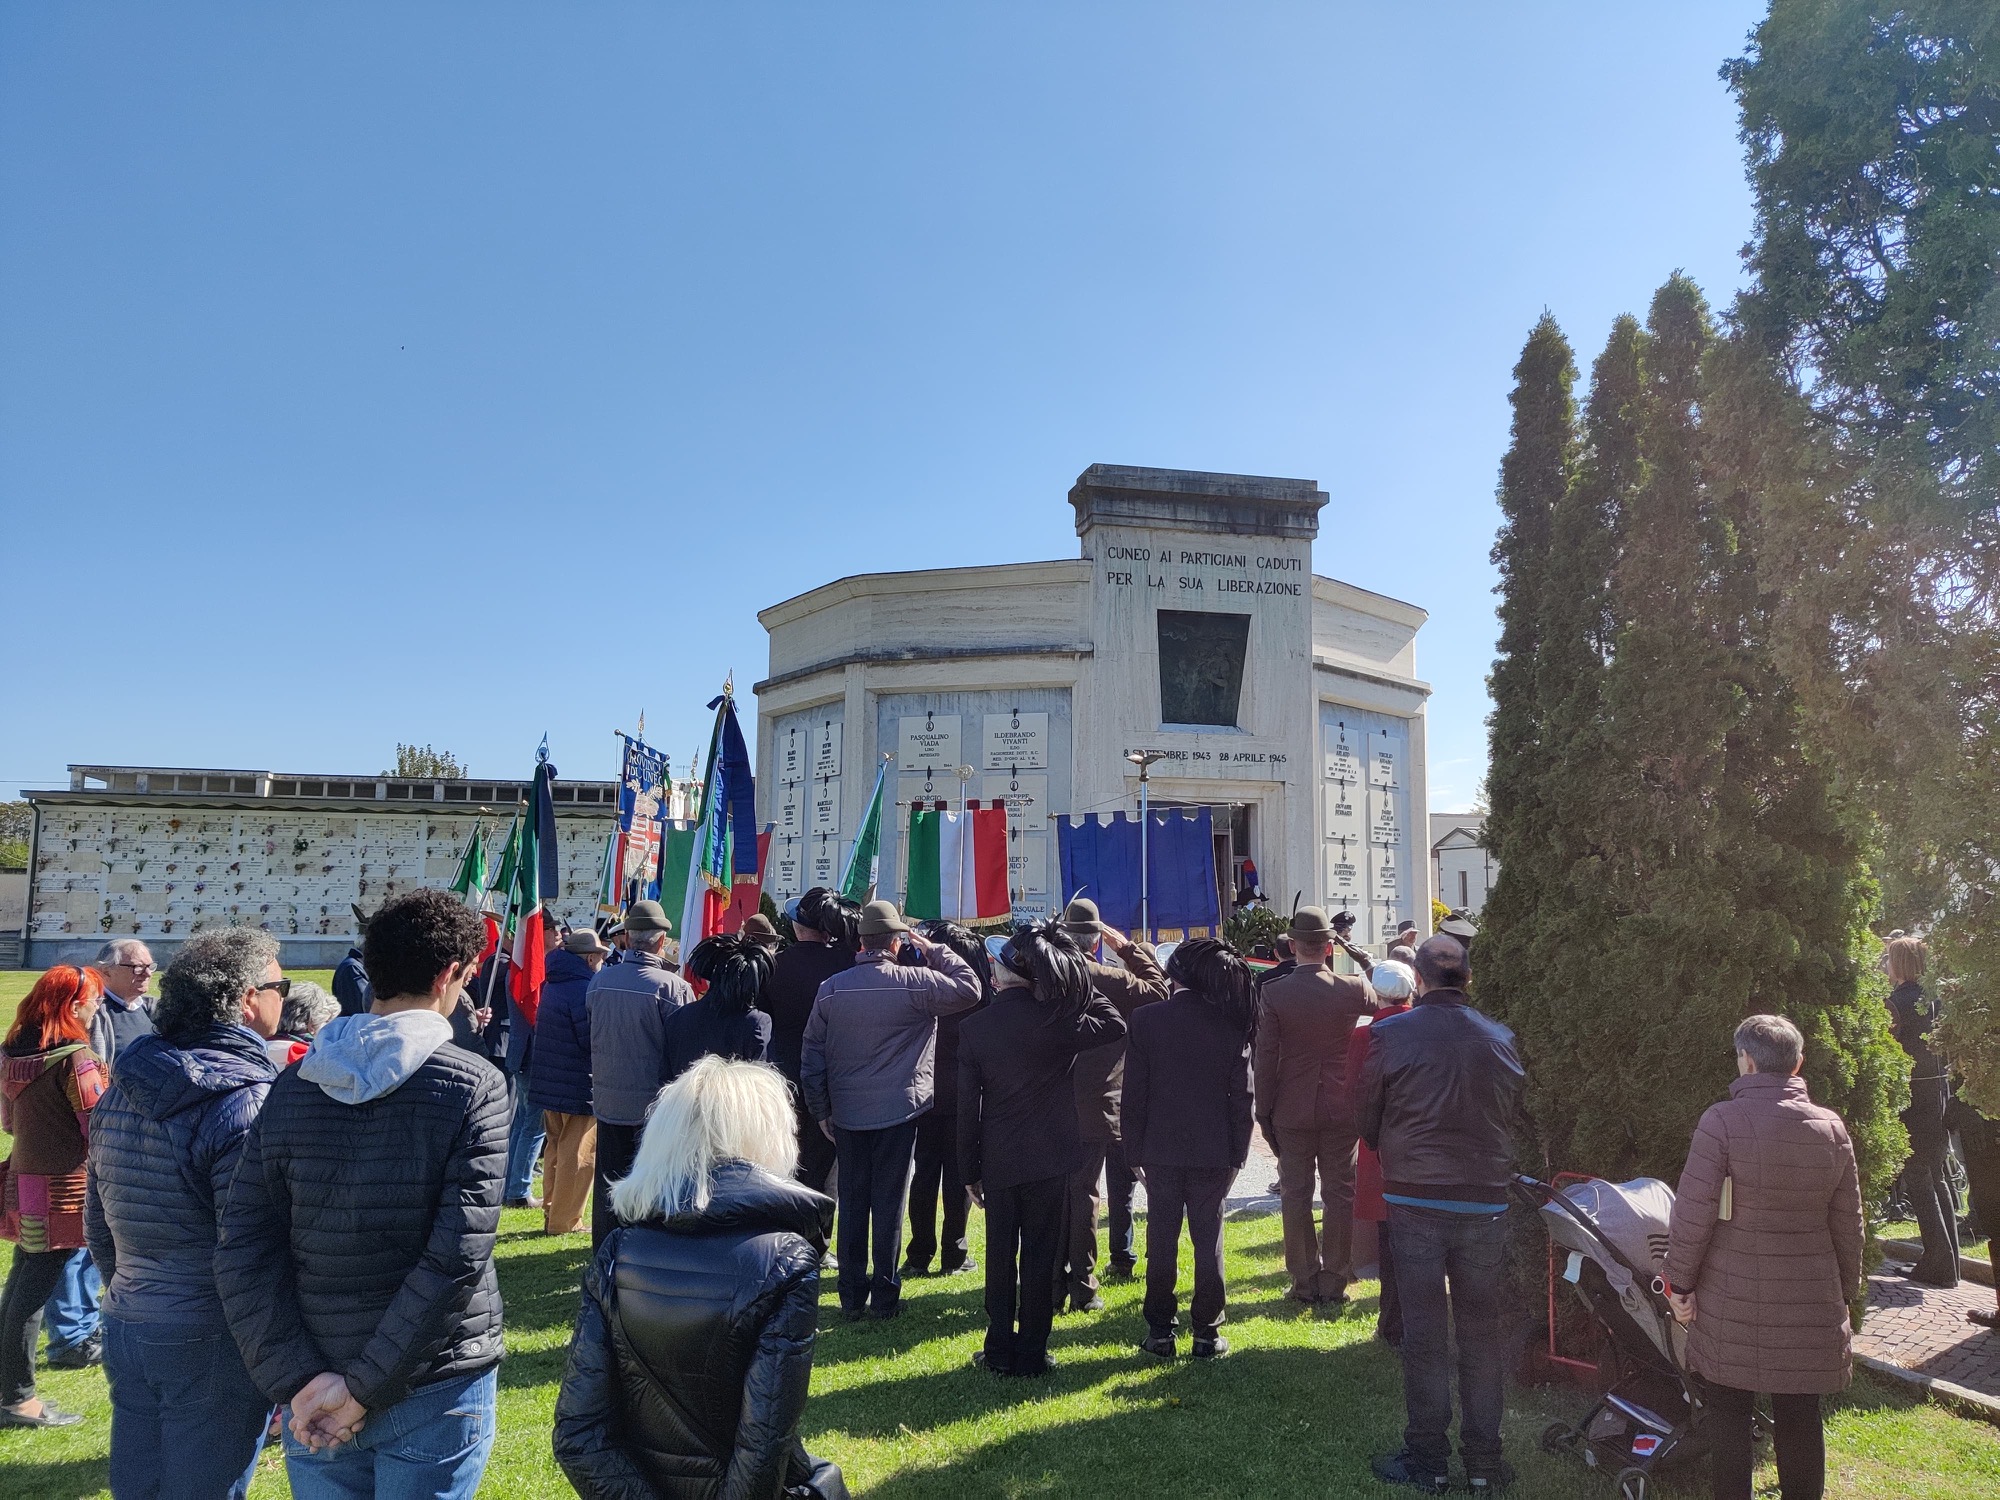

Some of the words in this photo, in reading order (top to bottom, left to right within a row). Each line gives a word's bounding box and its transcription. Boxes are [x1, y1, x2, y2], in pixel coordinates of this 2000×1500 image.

[1107, 546, 1150, 561] CUNEO
[1159, 550, 1172, 563] AI
[1180, 551, 1246, 568] PARTIGIANI
[1256, 556, 1302, 571] CADUTI
[1107, 572, 1133, 586] PER
[1148, 574, 1165, 588] LA
[1179, 577, 1204, 590] SUA
[1217, 579, 1302, 596] LIBERAZIONE
[1123, 749, 1129, 758] 8
[1192, 752, 1211, 761] 1943
[1219, 753, 1230, 761] 28
[1233, 753, 1266, 763] APRILE
[1269, 754, 1287, 763] 1945
